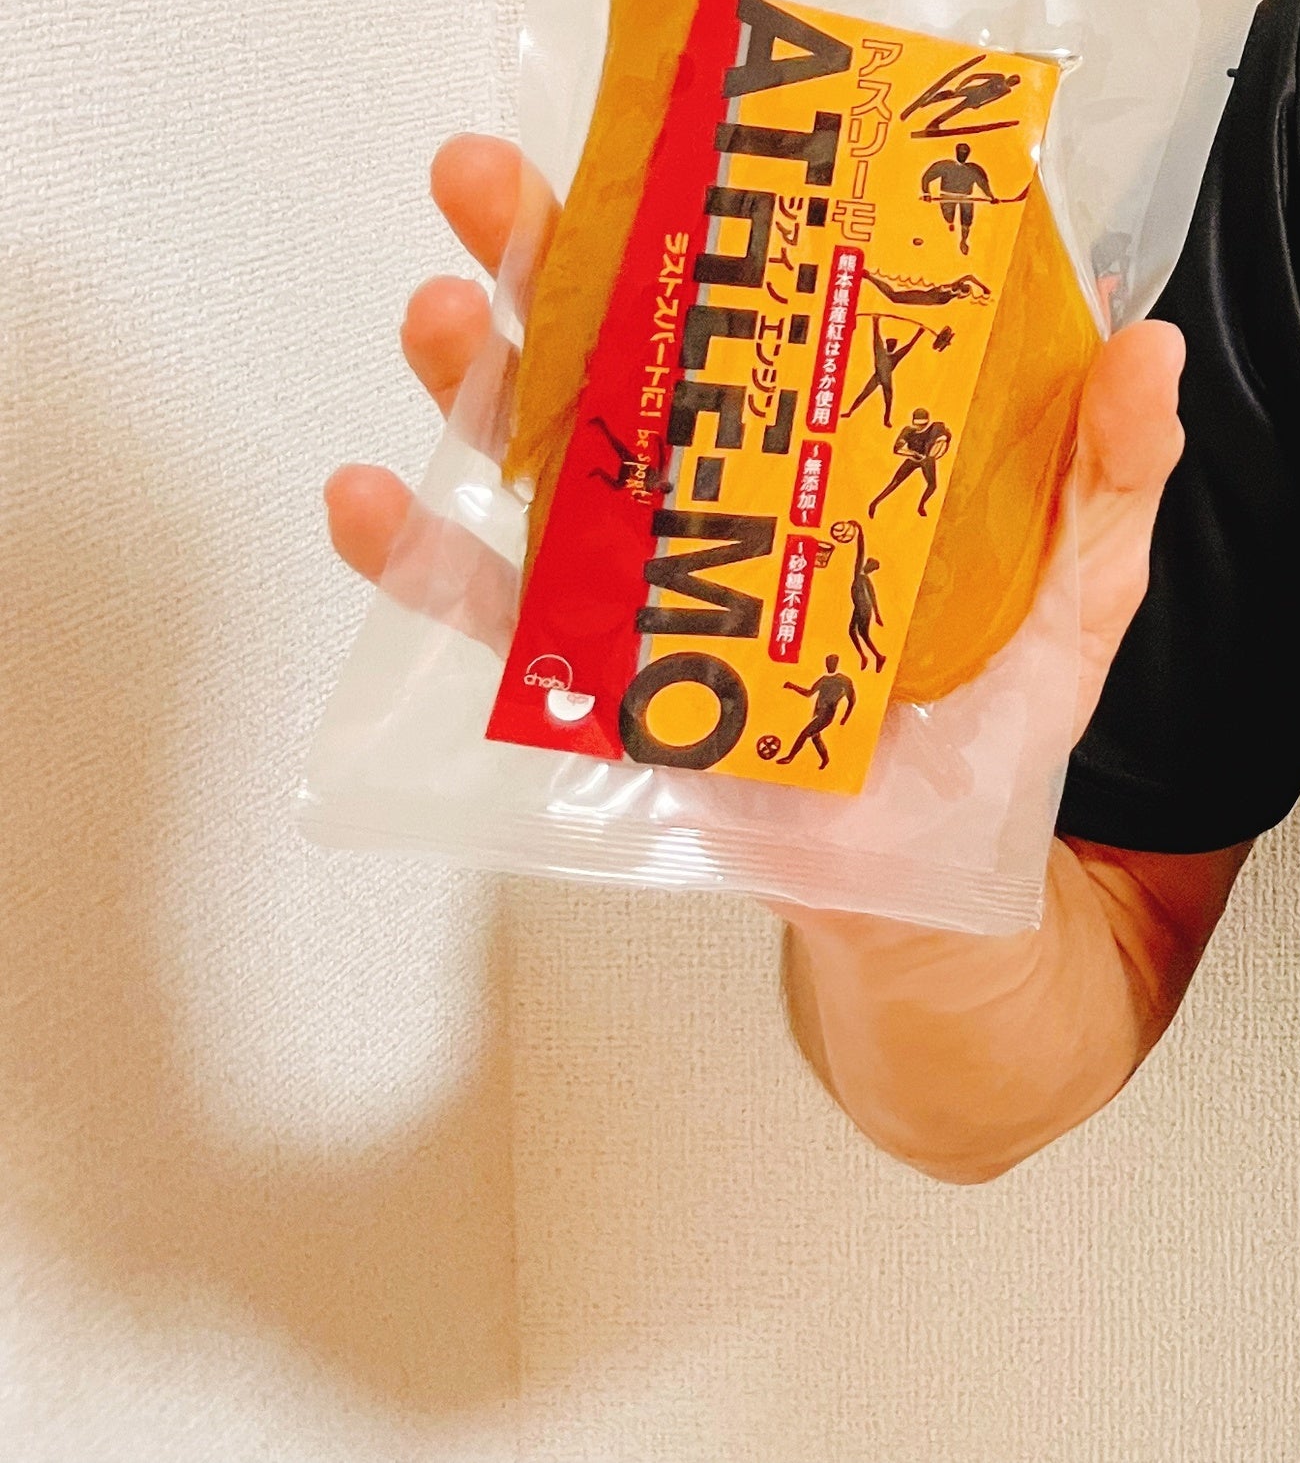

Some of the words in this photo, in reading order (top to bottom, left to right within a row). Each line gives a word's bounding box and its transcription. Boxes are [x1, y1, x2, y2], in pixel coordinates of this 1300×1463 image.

[831, 38, 902, 243] アスリーモ
[811, 252, 858, 426] 熊本県産紅はるか使用
